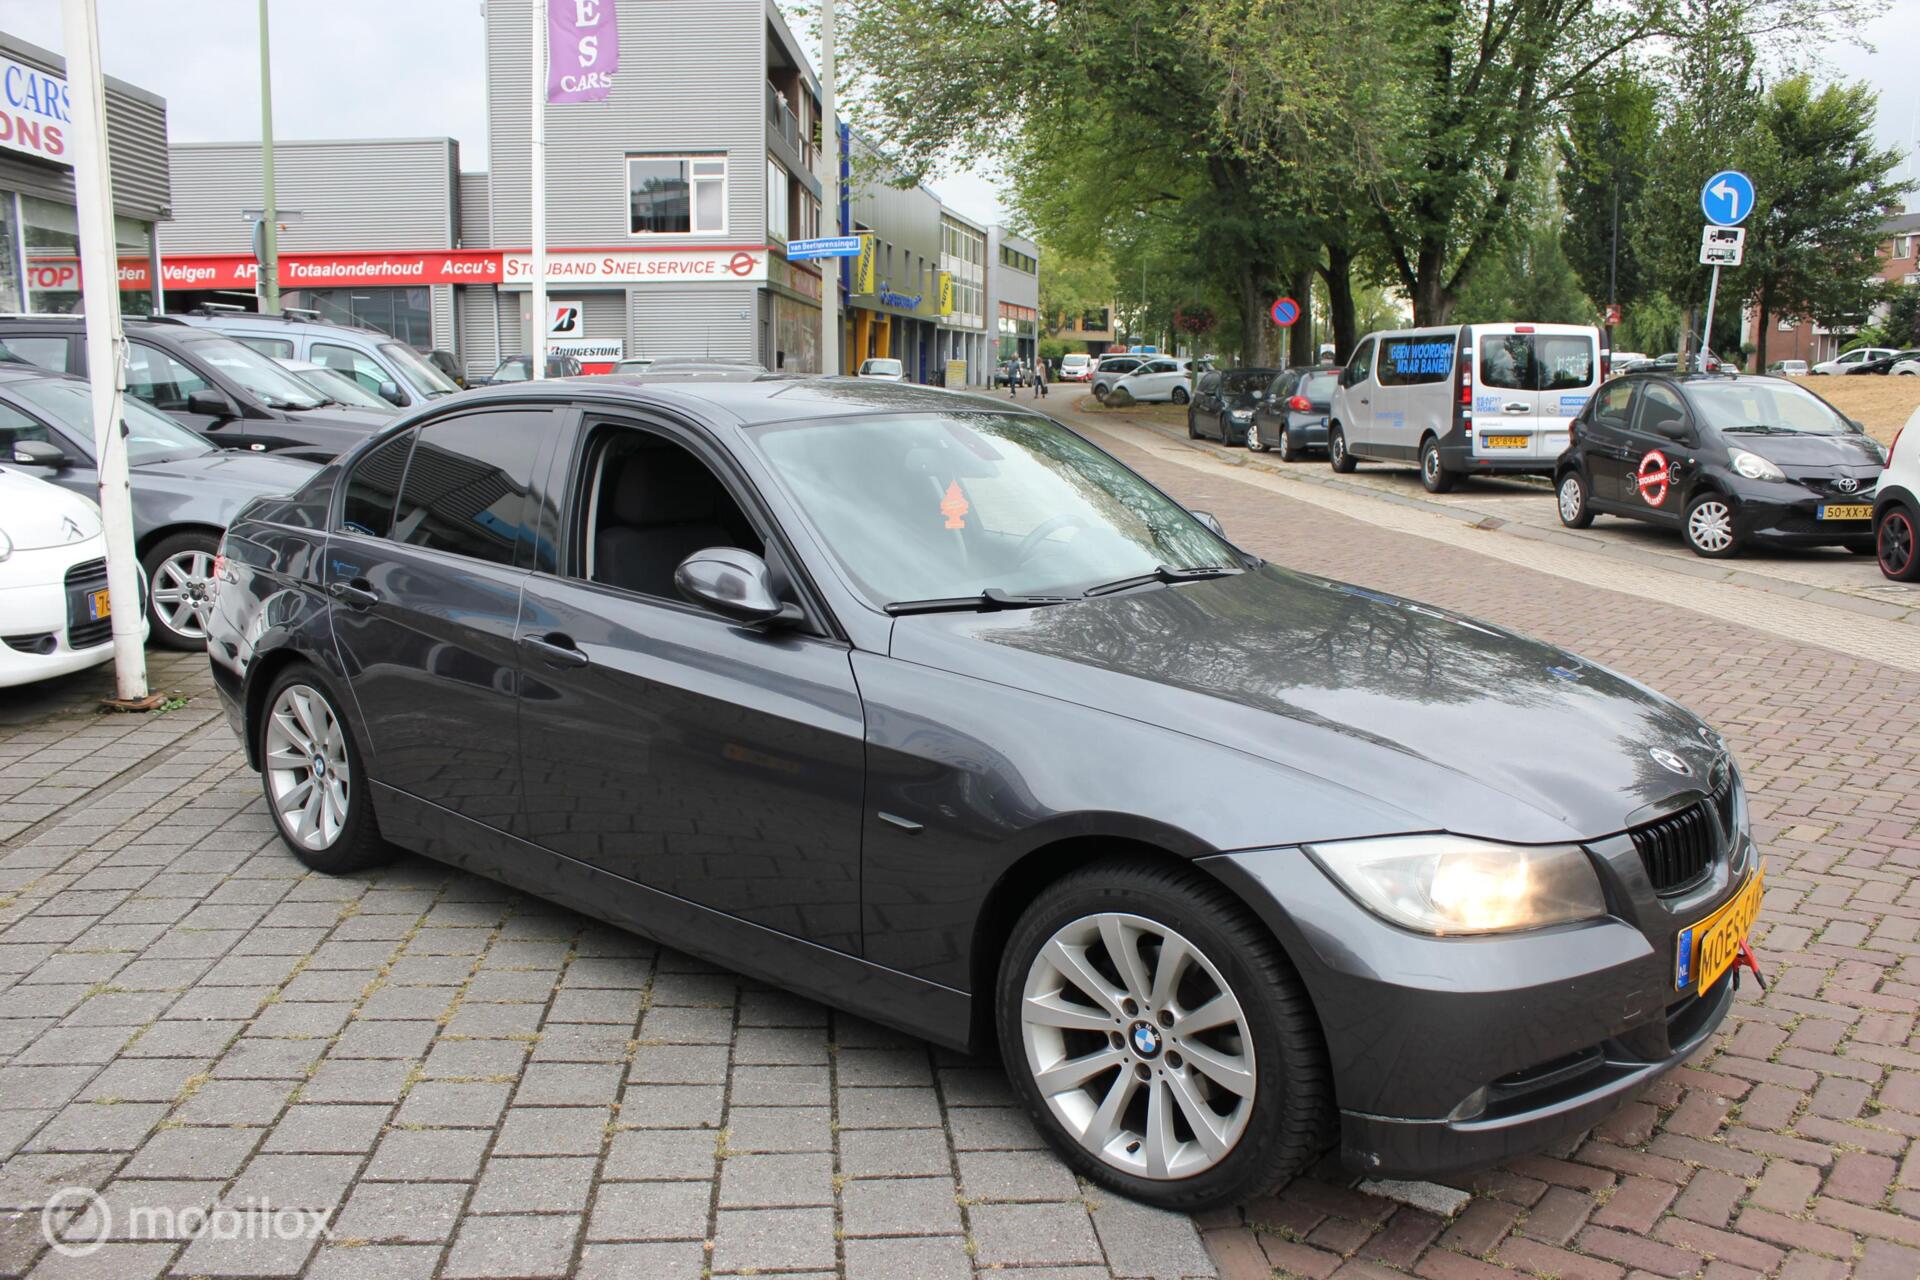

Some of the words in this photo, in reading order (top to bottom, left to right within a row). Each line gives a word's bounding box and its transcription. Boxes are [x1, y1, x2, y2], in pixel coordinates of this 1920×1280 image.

[560, 71, 612, 93] CARS
[163, 264, 216, 282] Velgen
[288, 261, 424, 277] Totaalonderhoud
[440, 260, 497, 275] Accu's
[550, 346, 621, 357] BRIDGESTONE
[1391, 345, 1411, 359] GEEN
[1411, 343, 1453, 358] WOORDEN
[1397, 359, 1419, 373] MAAR
[1421, 358, 1451, 373] BANEN
[1135, 1023, 1160, 1041] BMW
